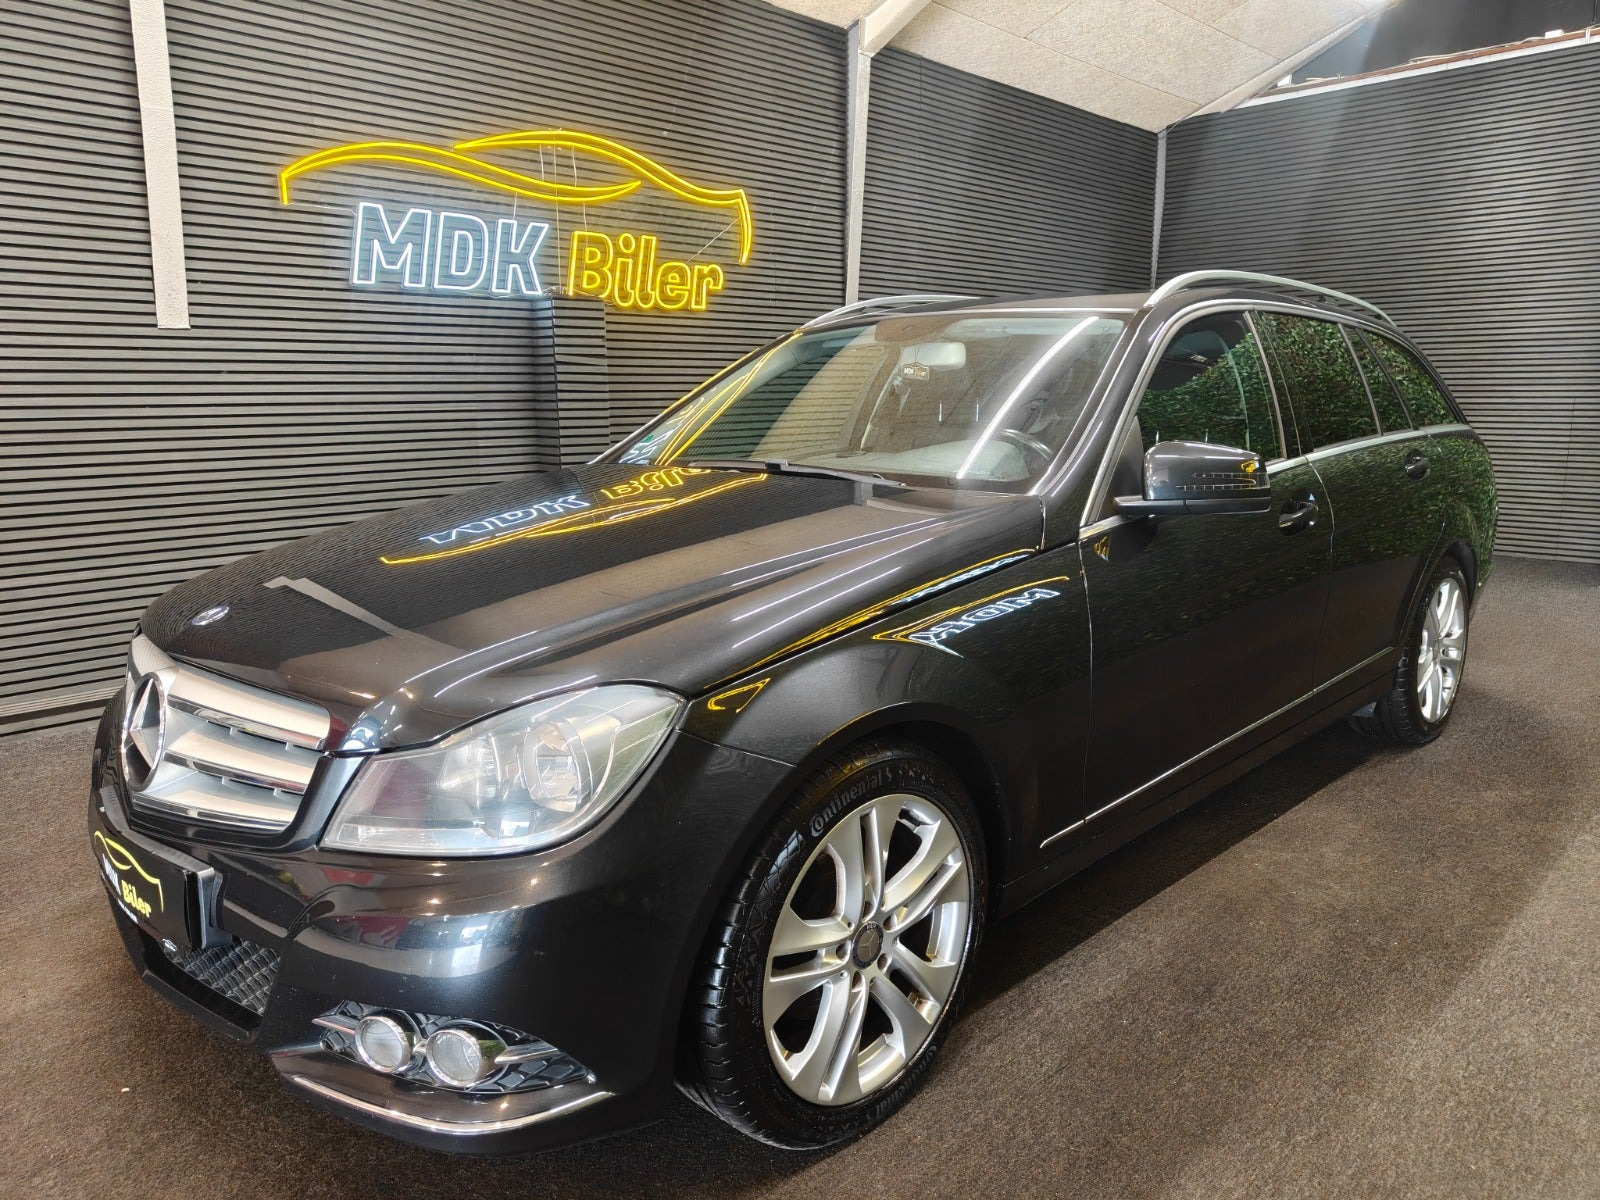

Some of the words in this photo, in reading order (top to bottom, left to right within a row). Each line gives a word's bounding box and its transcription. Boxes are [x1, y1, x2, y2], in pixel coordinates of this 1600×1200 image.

[351, 201, 550, 297] MDK
[567, 230, 725, 311] Biler
[810, 770, 882, 838] Continental
[121, 879, 152, 919] Biler
